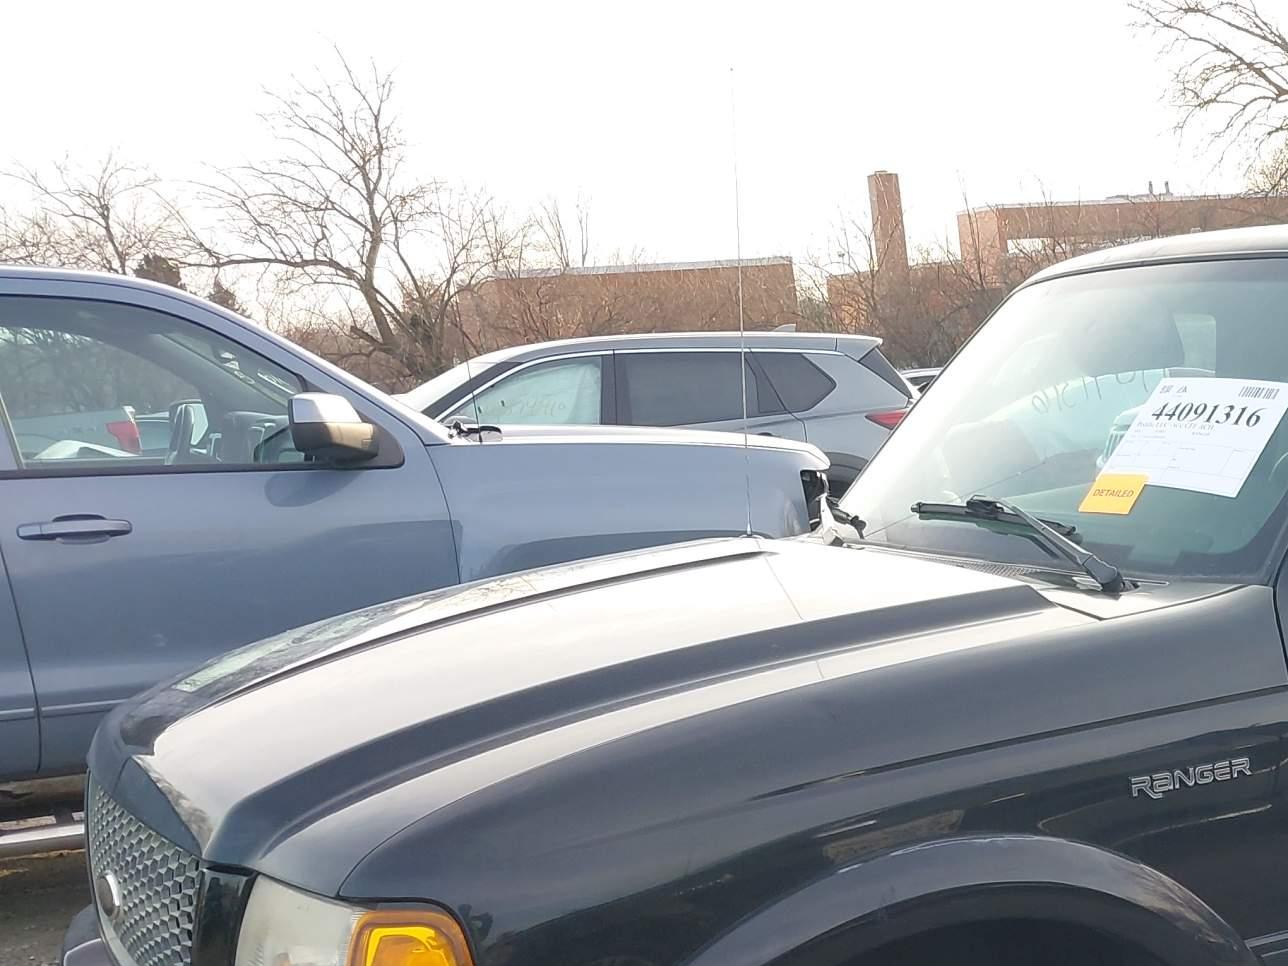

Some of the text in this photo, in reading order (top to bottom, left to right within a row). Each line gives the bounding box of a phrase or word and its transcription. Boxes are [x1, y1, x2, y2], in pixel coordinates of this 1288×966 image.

[1151, 402, 1267, 428] 44091316
[1092, 489, 1135, 497] DETAILED
[1131, 757, 1252, 799] RANGER
